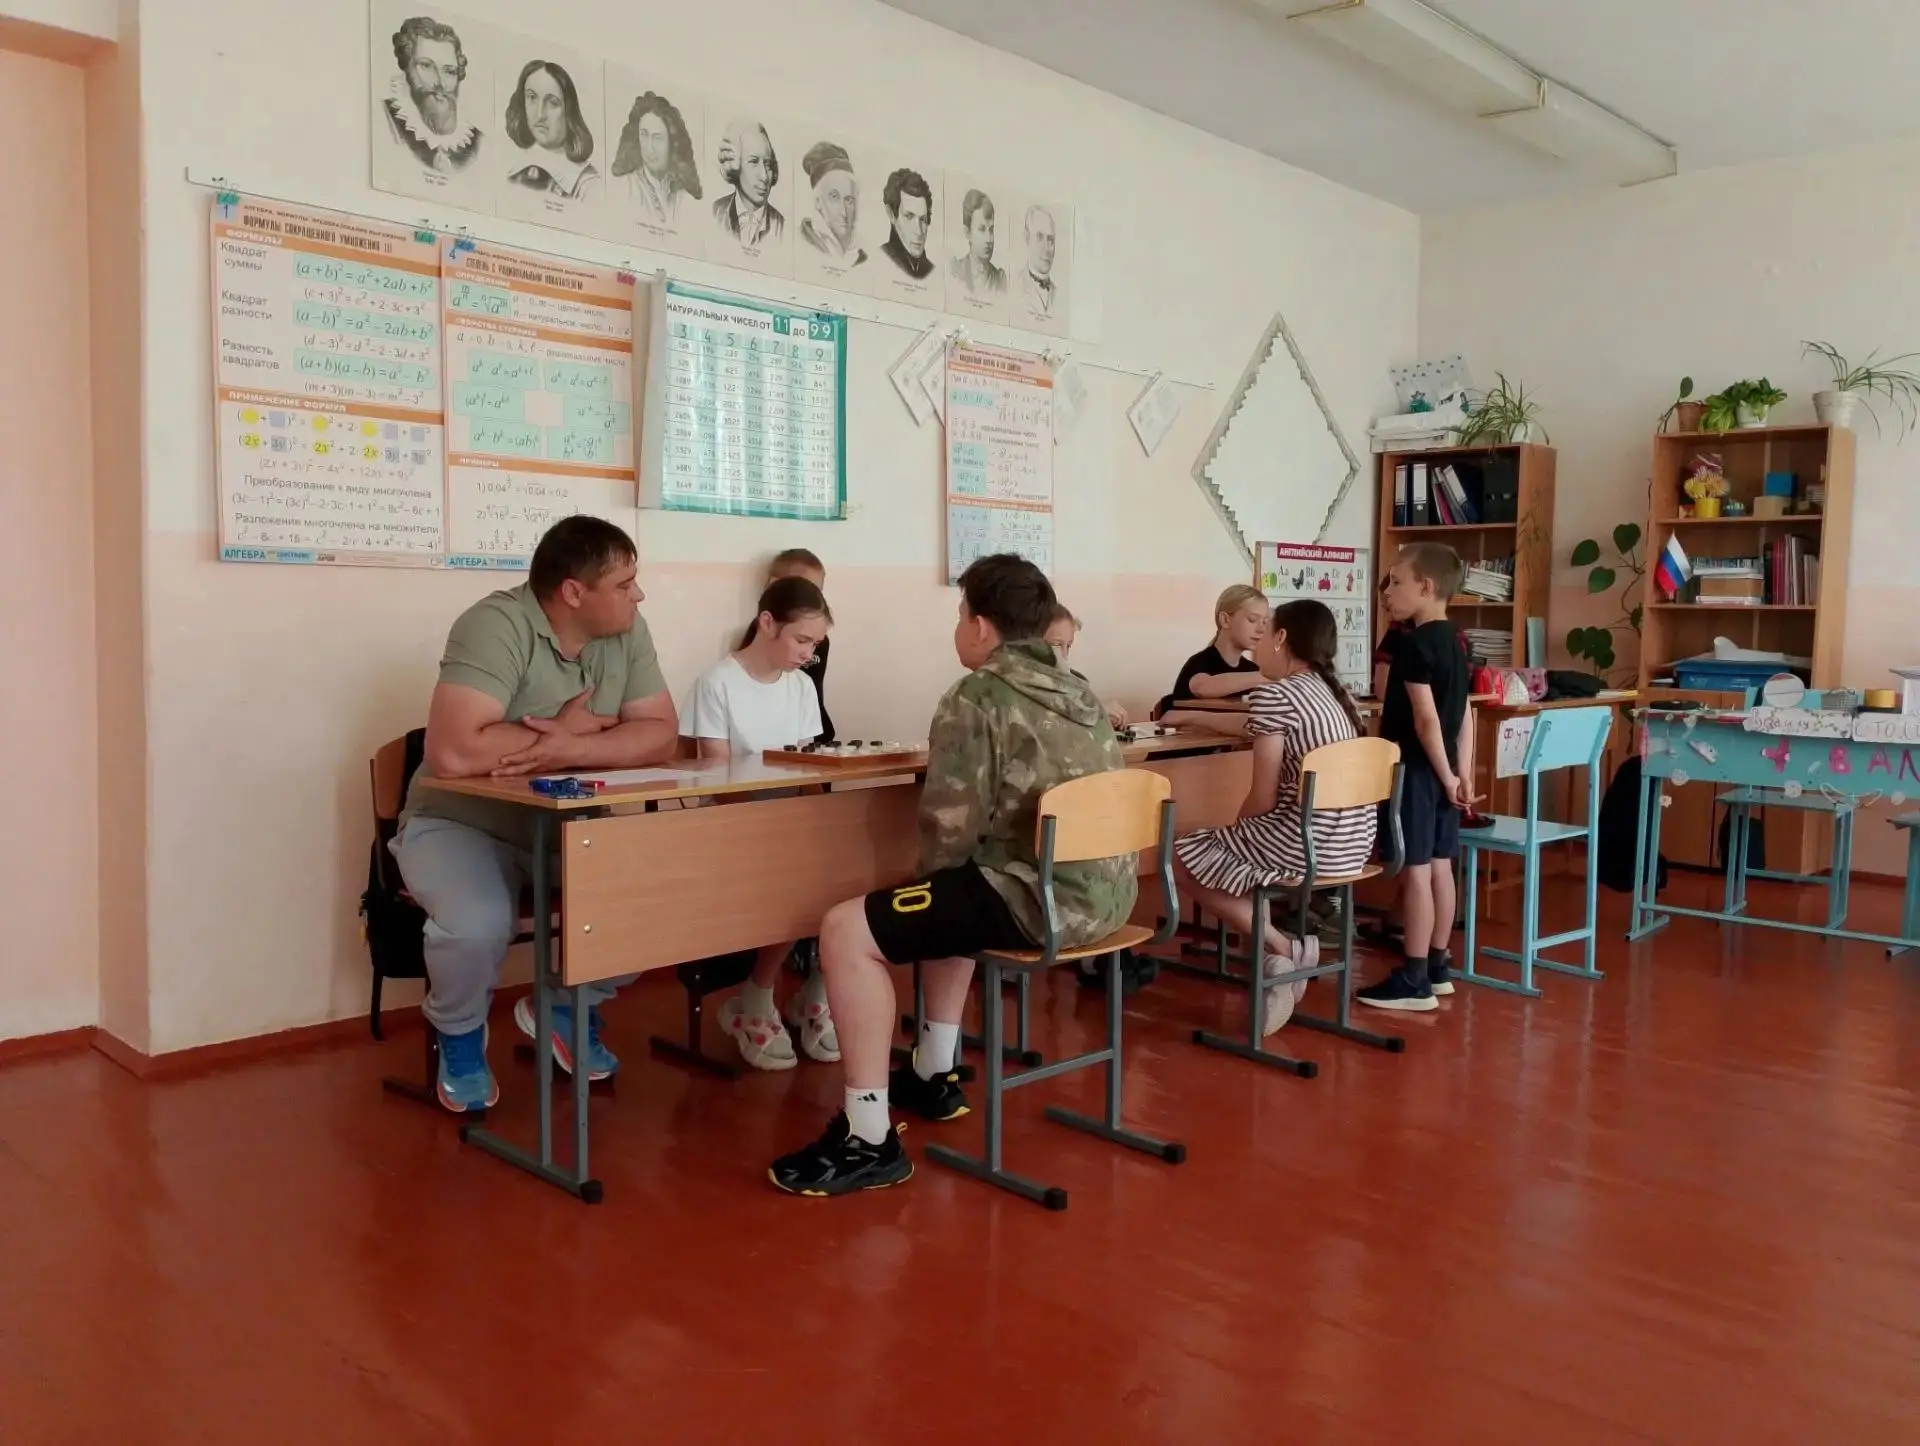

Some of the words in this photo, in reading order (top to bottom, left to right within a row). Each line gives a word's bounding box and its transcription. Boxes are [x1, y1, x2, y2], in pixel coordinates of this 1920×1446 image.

[225, 228, 282, 246] ФОРМУЛЫ
[243, 215, 281, 231] ФОРМУЛЫ
[339, 234, 380, 252] УМНОЖЕНИЯ
[221, 241, 268, 258] Квадрат
[225, 258, 263, 272] суммы
[221, 290, 268, 307] Квадрат
[222, 306, 273, 321] разности
[666, 303, 729, 322] НАТУРАЛЬНЫХ
[731, 316, 759, 328] ЧИСЕЛ
[760, 321, 771, 331] ОТ
[775, 316, 789, 333] 11
[793, 328, 805, 337] ДО
[810, 322, 832, 339] 99
[222, 338, 273, 356] Разность
[680, 324, 688, 339] 3
[704, 329, 712, 343] 4
[727, 332, 735, 347] 5
[750, 336, 758, 351] 6
[773, 341, 780, 354] 7
[792, 345, 800, 359] 8
[815, 348, 824, 361] 9
[222, 354, 280, 371] квадратов
[229, 390, 300, 407] ПРИМЕНЕНИЕ
[303, 400, 346, 413] ФОРМУЛ
[244, 475, 335, 492] Преобразование
[345, 483, 370, 496] виду
[373, 486, 432, 499] многочлена
[234, 513, 301, 527] Разложение
[304, 518, 366, 531] многочлена
[368, 522, 381, 531] на
[383, 523, 439, 535] множители
[224, 549, 266, 560] АЛГЕБРА
[450, 556, 488, 567] АЛГЕБРА
[1280, 547, 1322, 558] АНГЛИЙСКИЙ
[1323, 551, 1353, 560] АЛФАВИТ
[1279, 564, 1289, 576] Aa
[1306, 566, 1315, 578] Bb
[892, 881, 931, 913] 10
